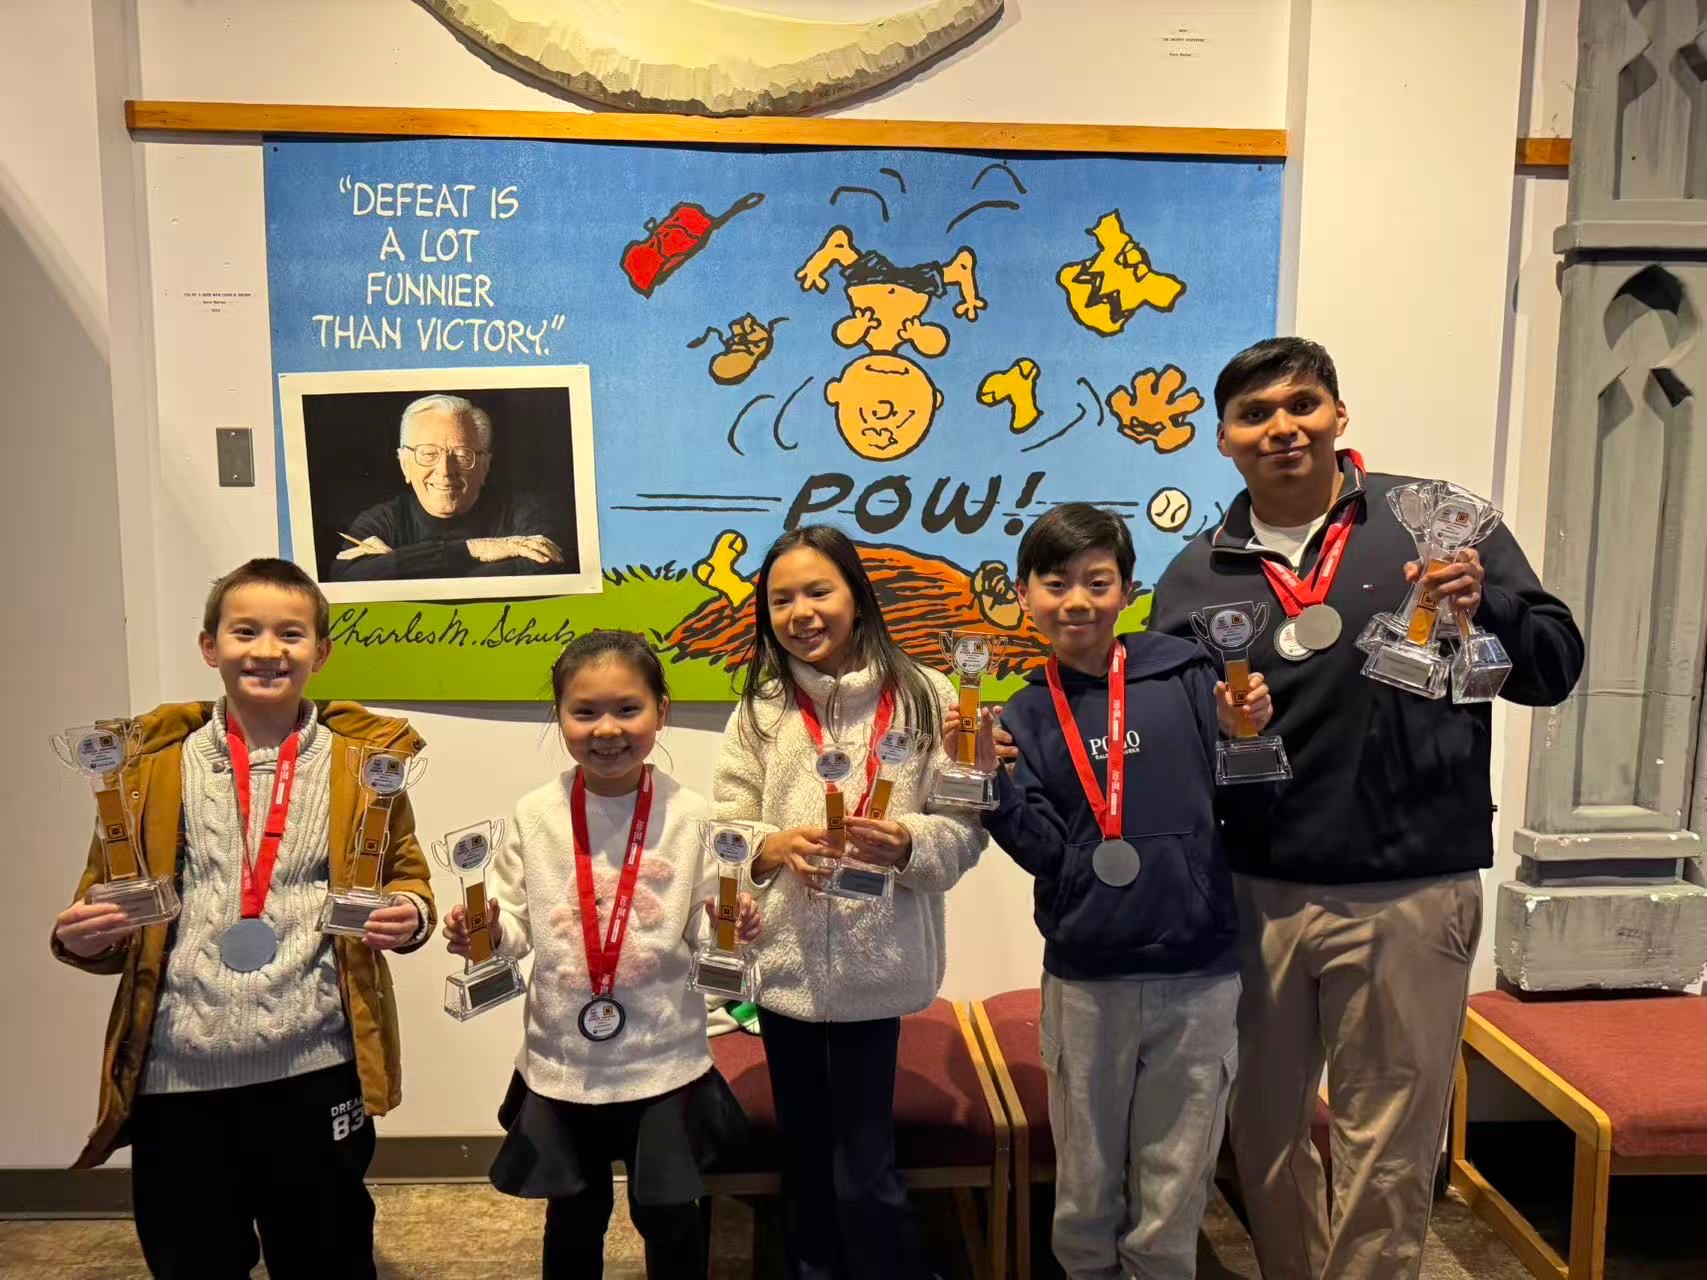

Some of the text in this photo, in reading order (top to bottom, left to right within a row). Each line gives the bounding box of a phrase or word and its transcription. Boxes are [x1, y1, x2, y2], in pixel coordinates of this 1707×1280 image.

[490, 185, 519, 219] IS
[379, 227, 480, 263] A LOT
[367, 271, 494, 307] FUNNIER
[312, 315, 401, 350] THAN
[782, 471, 1046, 536] POW!
[329, 607, 441, 647] Charles
[1089, 730, 1140, 756] POO
